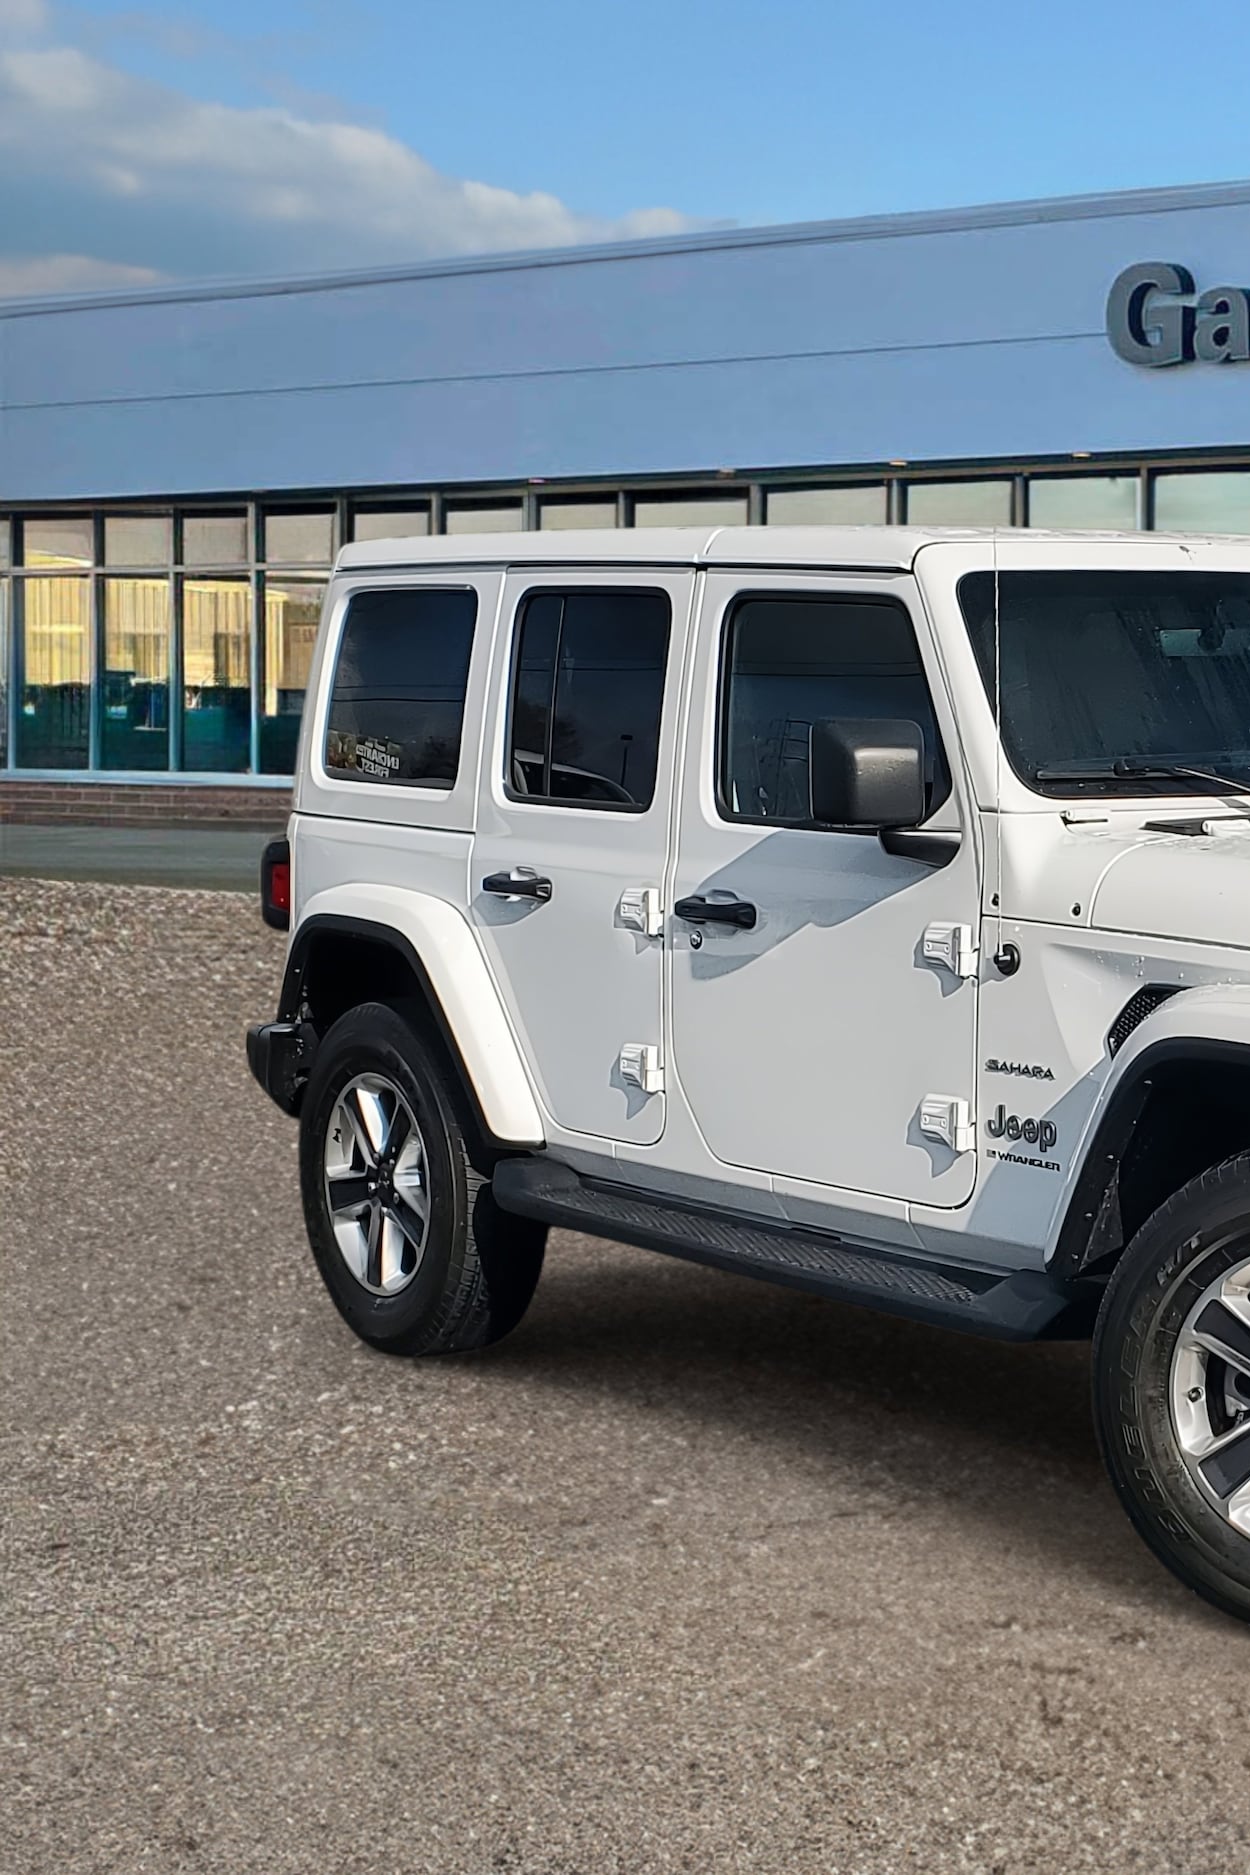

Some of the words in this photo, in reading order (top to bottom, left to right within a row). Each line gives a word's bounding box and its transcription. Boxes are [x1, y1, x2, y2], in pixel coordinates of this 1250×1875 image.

[984, 1059, 1056, 1081] SAHARA
[984, 1104, 1057, 1153] Jeep
[997, 1151, 1061, 1172] WRANGLER
